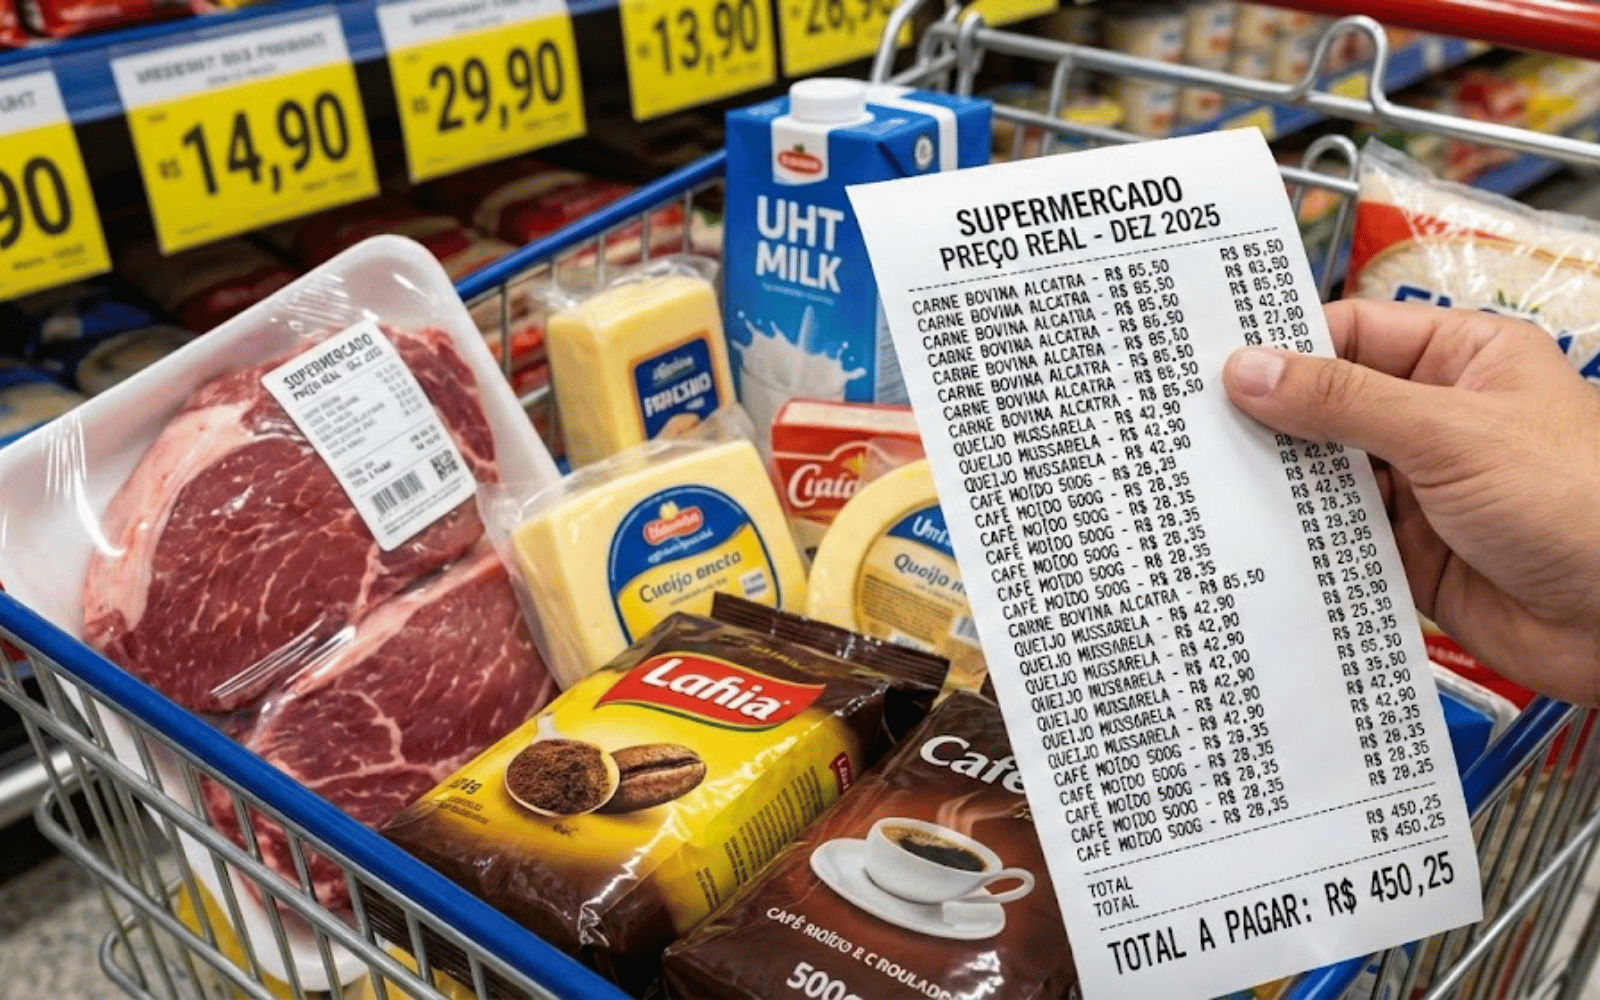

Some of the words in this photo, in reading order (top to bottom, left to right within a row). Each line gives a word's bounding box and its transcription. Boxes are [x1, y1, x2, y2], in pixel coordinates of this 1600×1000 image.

[428, 38, 565, 135] 29,90
[182, 91, 350, 195] 14,90
[757, 195, 845, 252] UHT
[956, 176, 1184, 236] SUPERMERCADO
[938, 236, 1019, 271] PREÇO
[1024, 226, 1088, 257] REAL
[1108, 213, 1156, 244] DEZ
[1160, 202, 1221, 235] 2025
[755, 239, 843, 294] MILK
[911, 293, 960, 316] CARNE
[1054, 376, 1116, 400] ALCATRA
[1060, 392, 1121, 417] ALCATRA
[1087, 875, 1133, 898] TOTAL
[1092, 893, 1140, 917] TOTAL
[1106, 925, 1187, 975] TOTAL
[1198, 916, 1216, 952] A
[1223, 892, 1312, 944] PAGAR:
[1323, 876, 1357, 916] R$
[1369, 850, 1454, 902] 450,25
